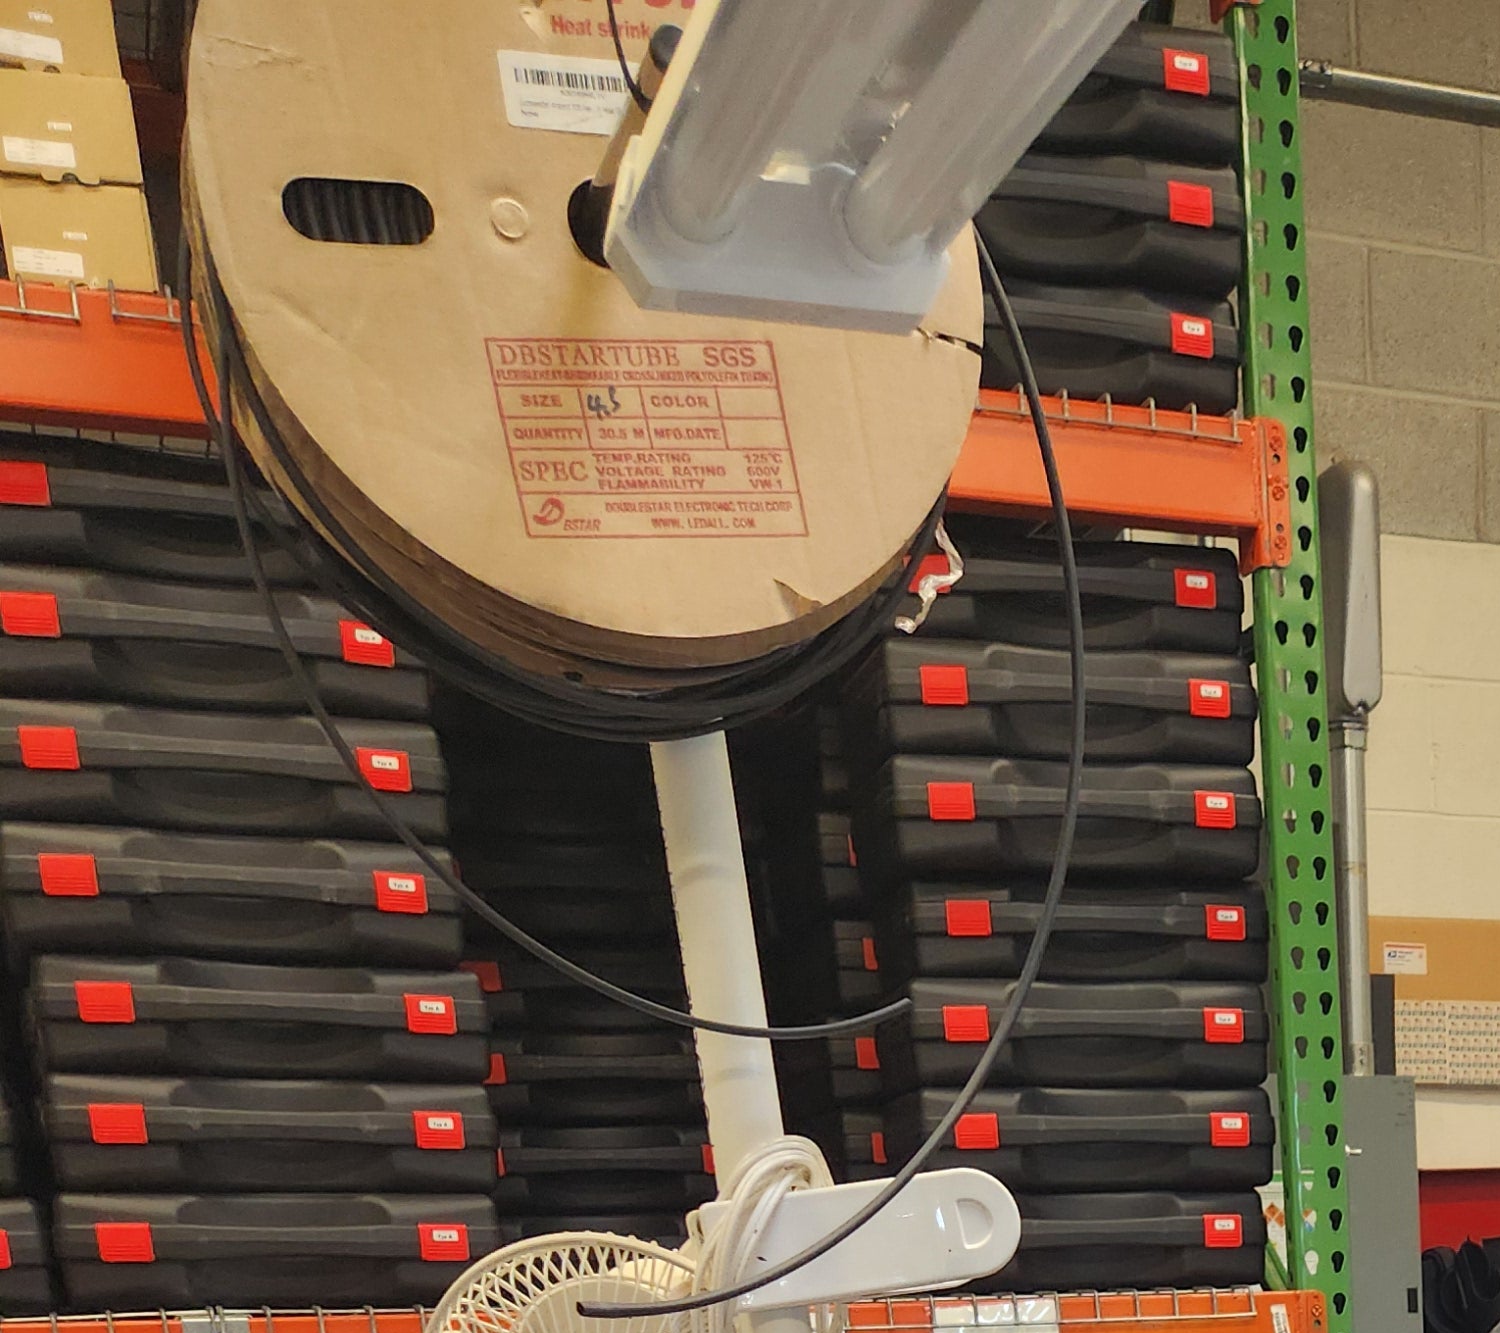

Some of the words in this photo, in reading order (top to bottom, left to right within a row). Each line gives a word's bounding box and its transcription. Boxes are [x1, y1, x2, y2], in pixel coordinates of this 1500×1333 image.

[551, 15, 593, 37] Heat
[599, 17, 650, 40] srink
[500, 345, 680, 367] DBSTARTUBE
[702, 346, 757, 367] SGS
[520, 394, 563, 408] SIZE
[651, 395, 709, 408] COLOR
[514, 428, 583, 440] QUANTITY
[599, 428, 628, 440] 30.5
[633, 428, 645, 440] M
[592, 453, 691, 464] TEMP.RATING
[520, 460, 588, 482] SPEC
[595, 466, 664, 477] VOLTAGE
[672, 466, 726, 477] RATING
[747, 466, 780, 477] 600V
[597, 479, 705, 490] FLAMMABILITY
[605, 501, 672, 513] DOUBLESTAR
[674, 502, 736, 513] ELECTRONIC
